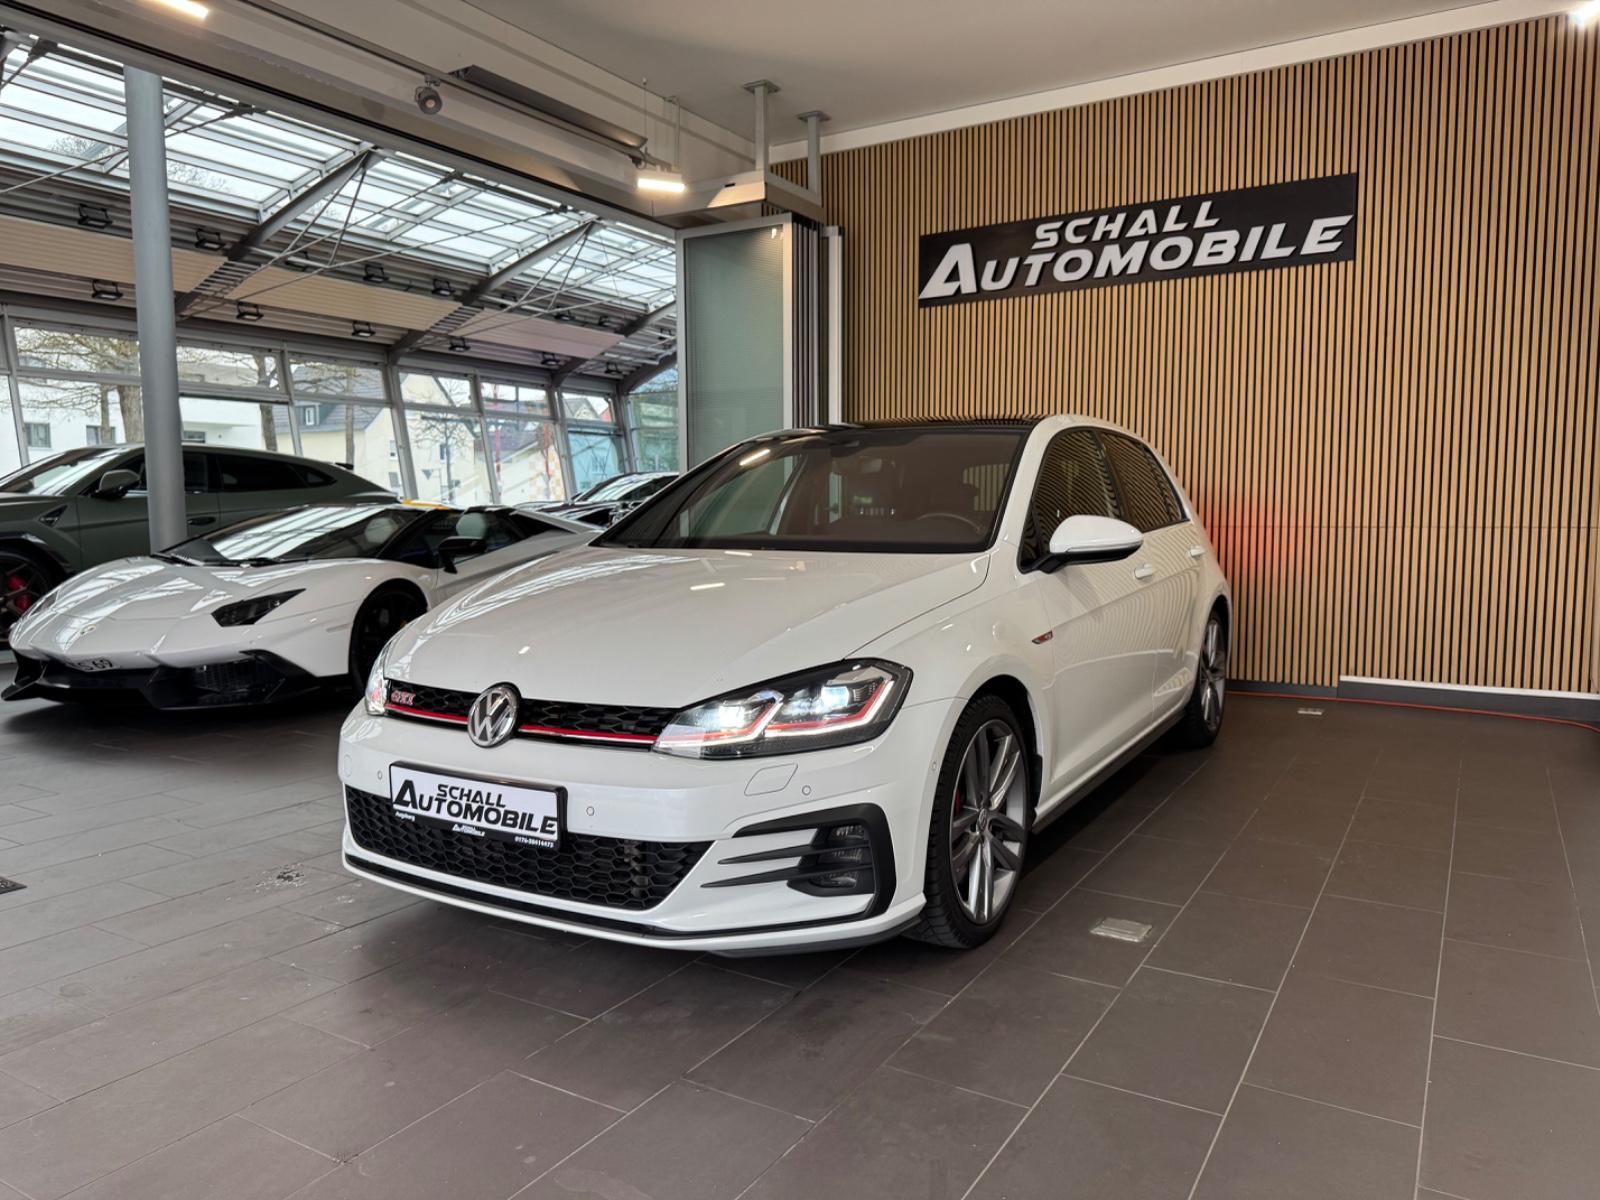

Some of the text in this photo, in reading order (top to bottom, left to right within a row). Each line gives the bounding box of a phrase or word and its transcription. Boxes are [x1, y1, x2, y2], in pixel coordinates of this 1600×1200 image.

[1031, 200, 1220, 250] SCHALL
[919, 214, 1354, 299] AUTOMOBILE
[394, 779, 558, 835] AUTOMOBILE
[437, 783, 506, 808] SCHALL
